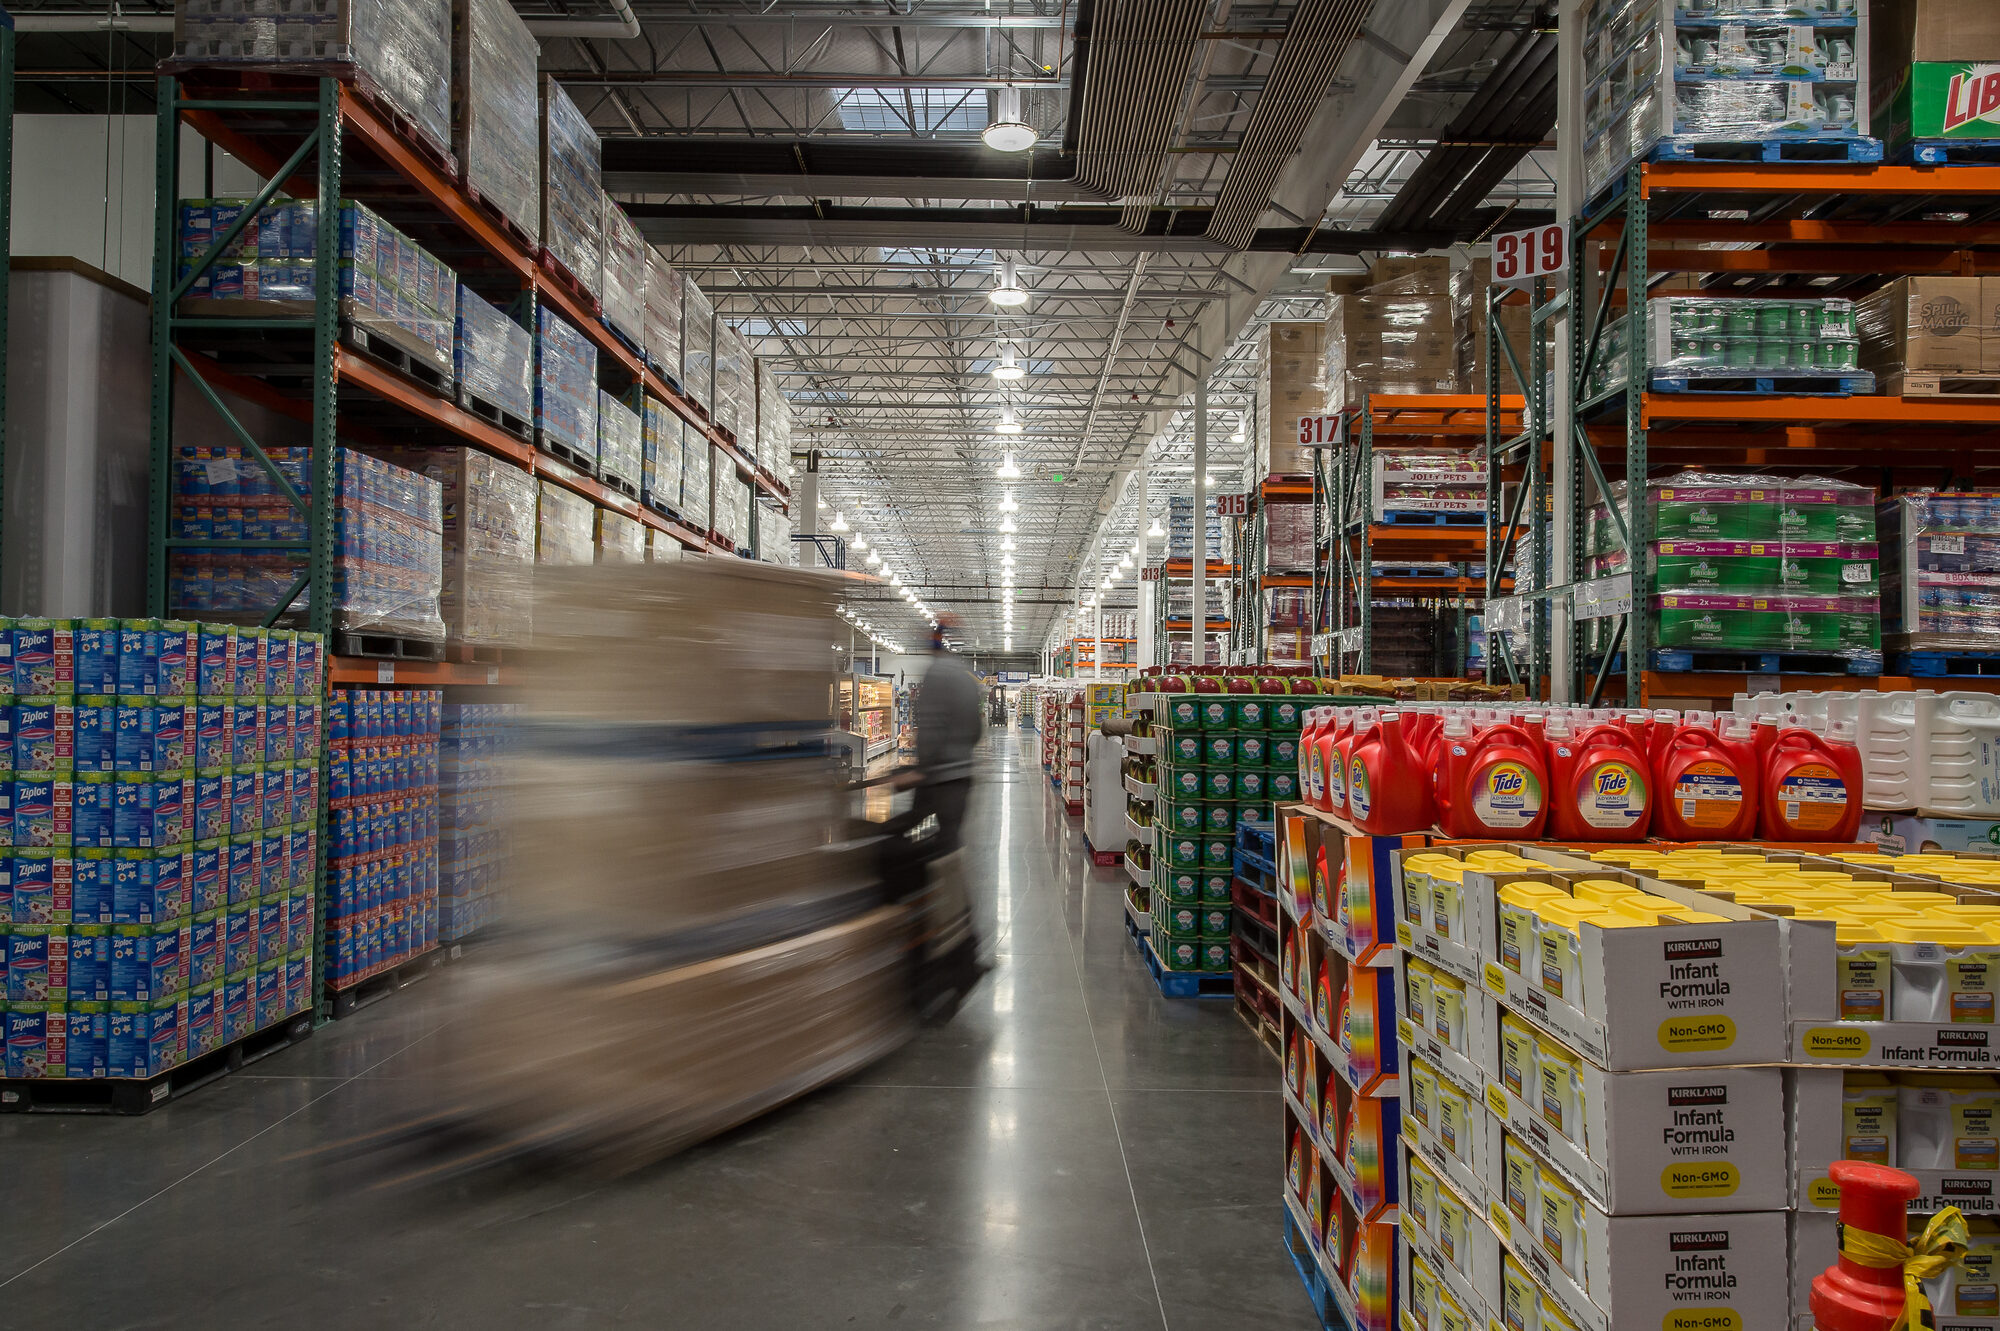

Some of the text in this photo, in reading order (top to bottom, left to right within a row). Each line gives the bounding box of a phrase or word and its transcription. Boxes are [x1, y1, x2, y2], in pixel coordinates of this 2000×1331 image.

[217, 210, 239, 221] Ziploc
[1496, 226, 1563, 280] 319
[217, 269, 239, 280] Ziploc
[1921, 303, 1960, 317] SPILL
[1920, 314, 1969, 329] MAGIC
[1300, 416, 1340, 444] 317
[1410, 473, 1440, 481] JOLLY
[1217, 494, 1246, 515] 315
[1443, 501, 1468, 509] PETS
[1690, 514, 1718, 522] Palmolive
[1695, 545, 1706, 553] 2x
[1142, 568, 1160, 581] 313
[1690, 569, 1718, 577] Palmolive
[1694, 622, 1721, 630] Palmolive
[19, 634, 48, 649] Ziploc
[81, 632, 100, 642] Ziploc
[122, 633, 142, 643] Ziploc
[164, 636, 183, 649] Ziploc
[206, 638, 224, 651] Ziploc
[238, 640, 255, 653] Ziploc
[271, 643, 286, 655] Ziploc
[299, 645, 313, 656] Ziploc
[21, 710, 49, 725] Ziploc
[79, 709, 97, 719] Ziploc
[160, 712, 181, 725] Ziploc
[203, 710, 221, 723] Ziploc
[77, 785, 96, 795] Ziploc
[201, 781, 219, 796] Ziploc
[1494, 773, 1523, 794] Tide
[1599, 773, 1628, 794] Tide
[20, 786, 48, 801] Ziploc
[159, 785, 179, 800] Ziploc
[76, 862, 96, 871] Ziploc
[198, 854, 216, 869] Ziploc
[19, 862, 47, 877] Ziploc
[159, 860, 179, 877] Ziploc
[14, 940, 42, 954] Ziploc
[72, 938, 92, 949] Ziploc
[156, 935, 176, 952] Ziploc
[1667, 940, 1720, 952] KIRKLAND
[1670, 962, 1719, 980] Infant
[1659, 979, 1730, 998] Formula
[193, 997, 211, 1015] Ziploc
[1510, 990, 1525, 1010] Infant
[1526, 999, 1549, 1026] Formula
[1667, 998, 1724, 1009] WITH IRON
[70, 1015, 90, 1025] Ziploc
[153, 1010, 174, 1029] Ziploc
[1669, 1024, 1726, 1037] Non-GMO
[1940, 1032, 1986, 1040] KIRKLAND
[1812, 1035, 1861, 1046] Non-GMO
[1882, 1046, 1990, 1062] Infant Formula
[1671, 1087, 1724, 1098] KIRKLAND
[1673, 1109, 1724, 1126] Infant
[1512, 1116, 1551, 1159] Infant Formula
[1663, 1126, 1735, 1144] Formula
[1671, 1145, 1728, 1156] WITH IRON
[1672, 1171, 1729, 1183] Non-GMO
[1944, 1181, 1990, 1189] KIRKLAND
[1673, 1233, 1727, 1243] KIRKLAND
[1675, 1255, 1726, 1272] Infant
[1665, 1271, 1737, 1290] Formula
[1672, 1291, 1730, 1301] WITH IRON
[1674, 1317, 1731, 1328] Non-GMO
